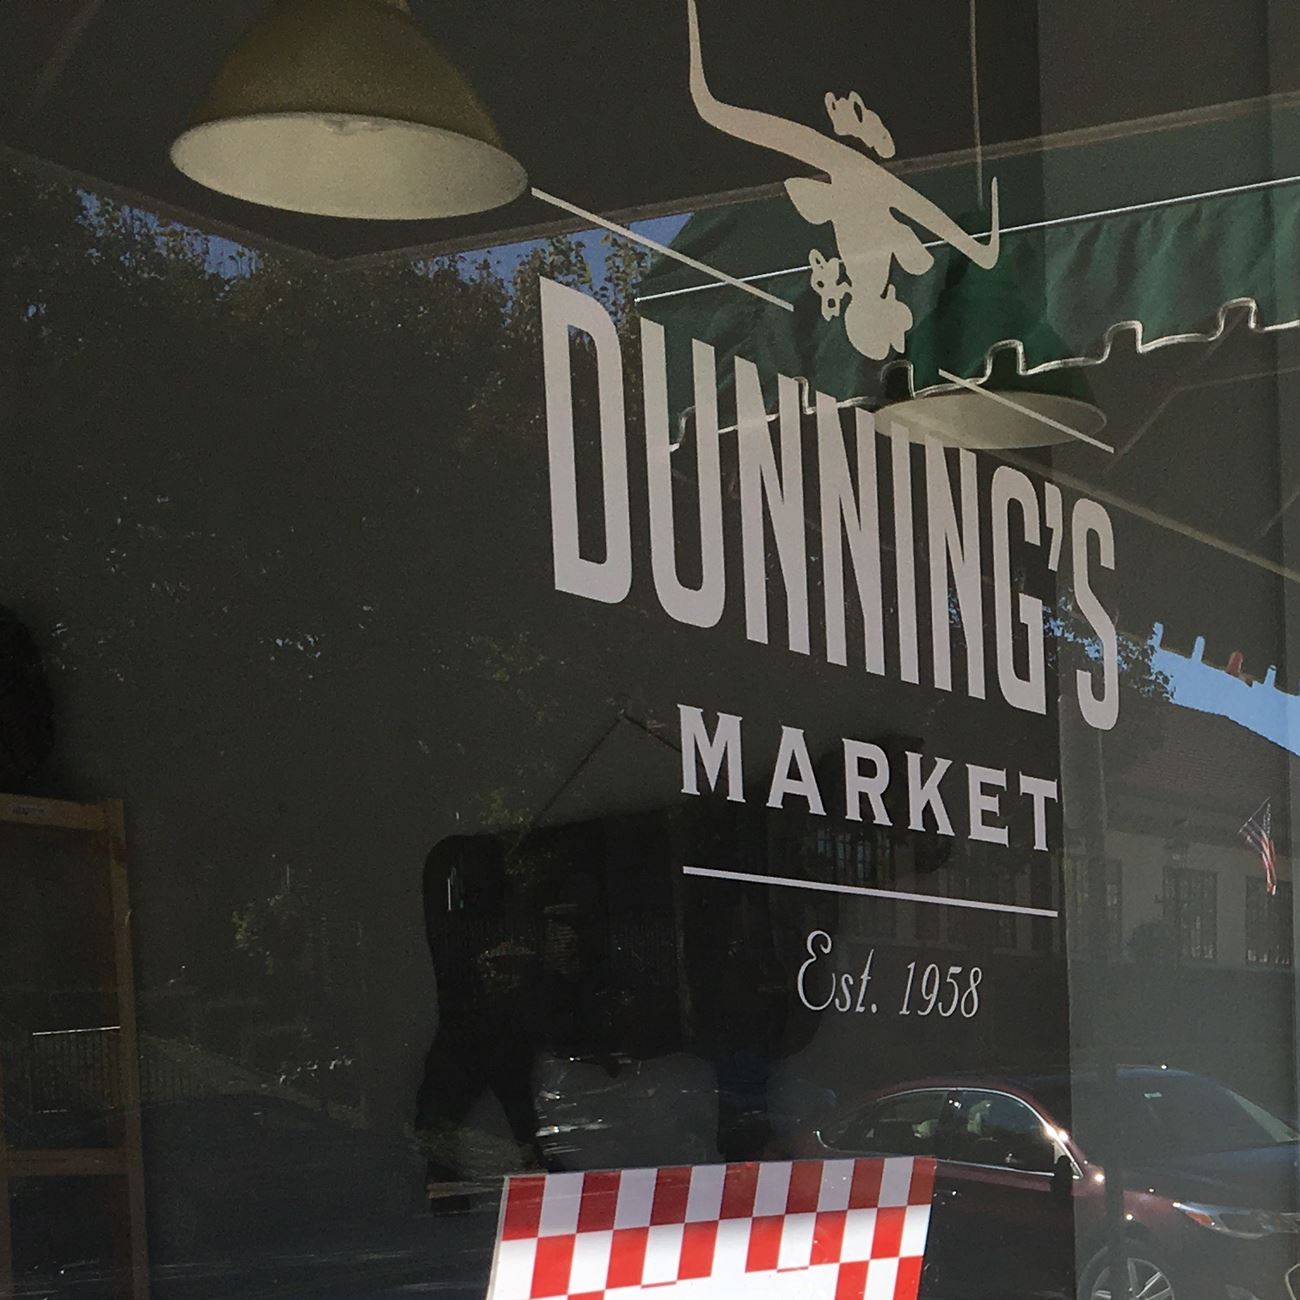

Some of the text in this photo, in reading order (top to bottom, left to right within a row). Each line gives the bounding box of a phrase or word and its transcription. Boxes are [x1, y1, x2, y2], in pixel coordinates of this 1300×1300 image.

[539, 276, 1120, 731] DUNNING'S
[677, 704, 1058, 852] MARKET
[796, 929, 983, 1019] Est. 1958
